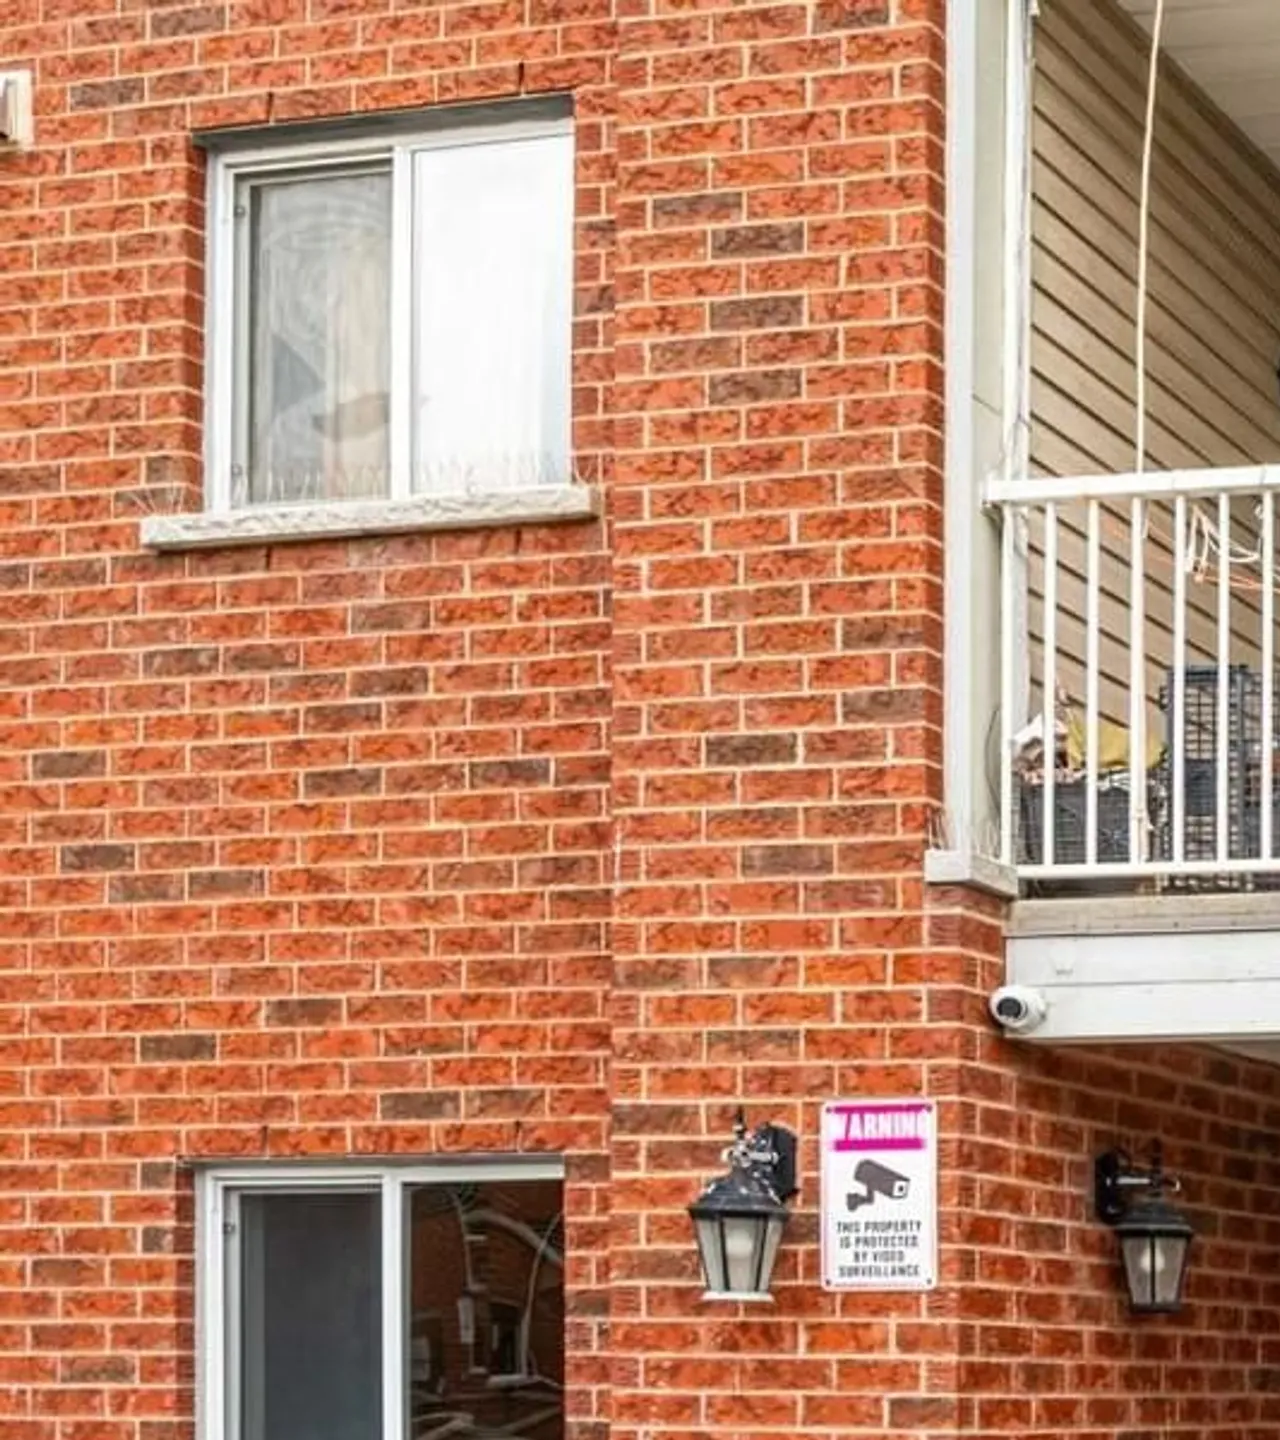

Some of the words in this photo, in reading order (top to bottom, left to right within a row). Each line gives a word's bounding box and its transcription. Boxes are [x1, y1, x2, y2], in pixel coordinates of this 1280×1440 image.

[837, 1220, 861, 1233] THIS
[864, 1219, 922, 1233] PROPERTY
[840, 1236, 851, 1249] IS
[855, 1235, 919, 1248] PROTECTED
[853, 1251, 868, 1263] BY
[872, 1250, 905, 1263] VIDEO
[838, 1265, 920, 1278] SURVEILLANCE
